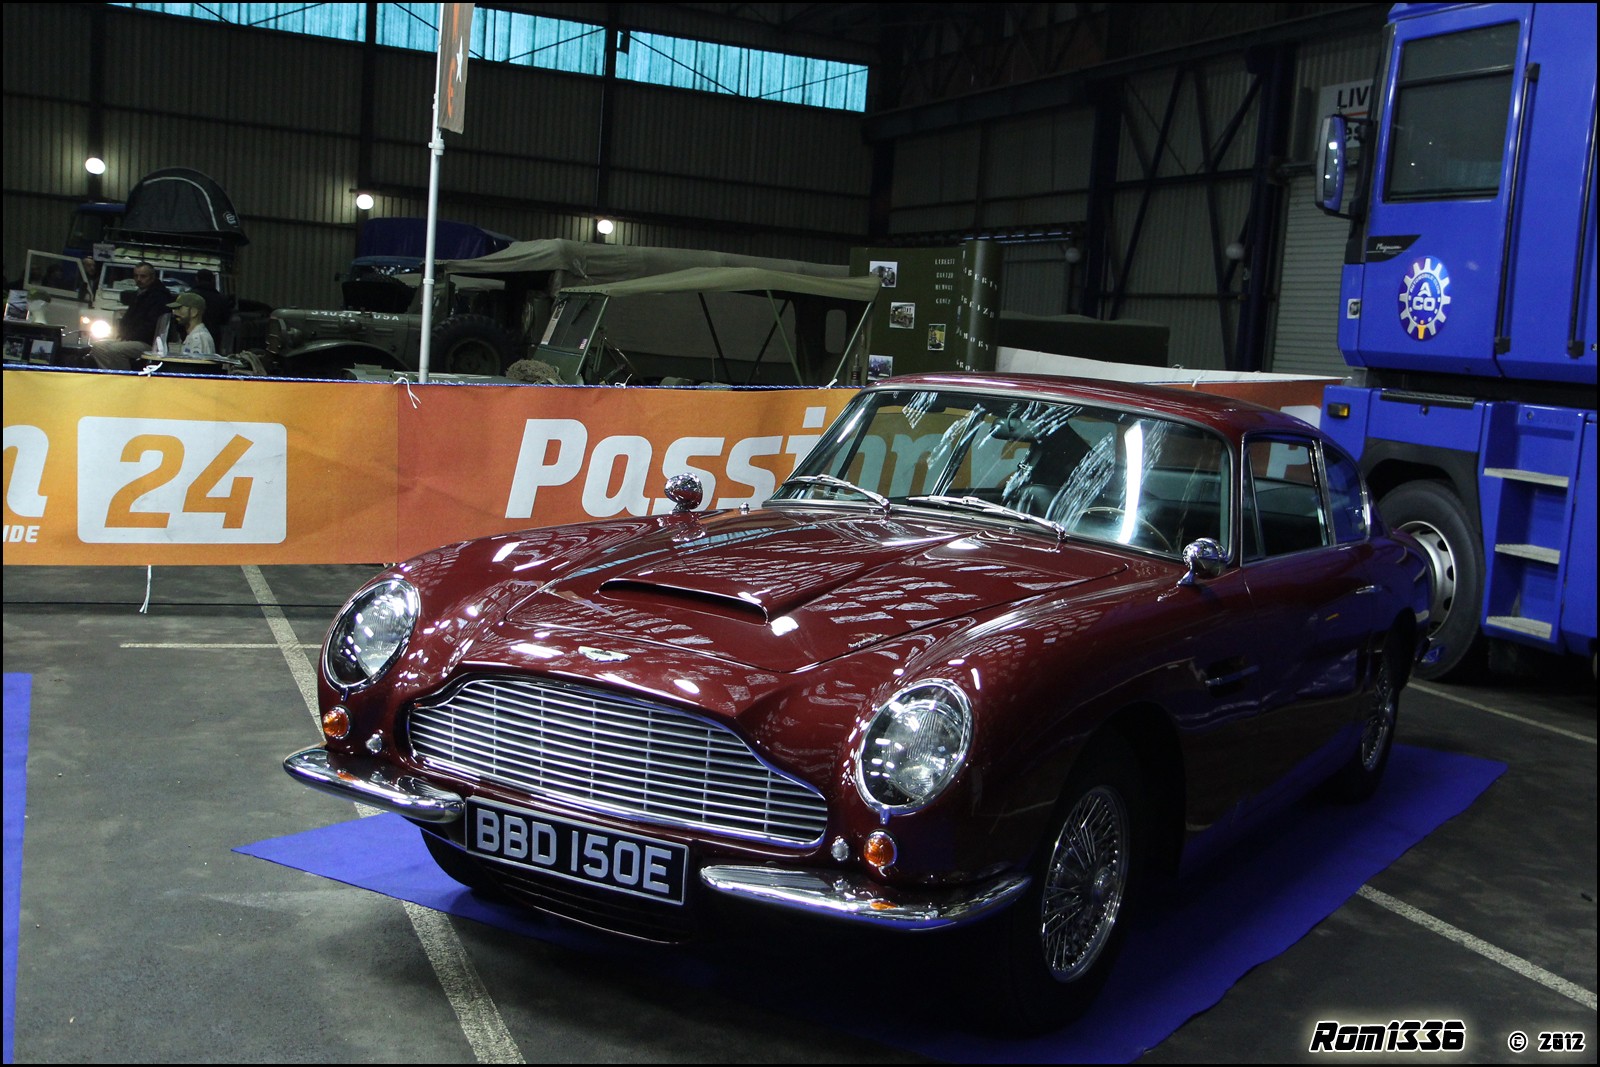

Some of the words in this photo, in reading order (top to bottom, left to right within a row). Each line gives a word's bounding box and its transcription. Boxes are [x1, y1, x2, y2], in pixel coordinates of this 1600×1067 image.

[1337, 86, 1369, 108] LIV
[104, 433, 255, 530] 24
[476, 807, 557, 866] BBD
[570, 829, 672, 894] 150E
